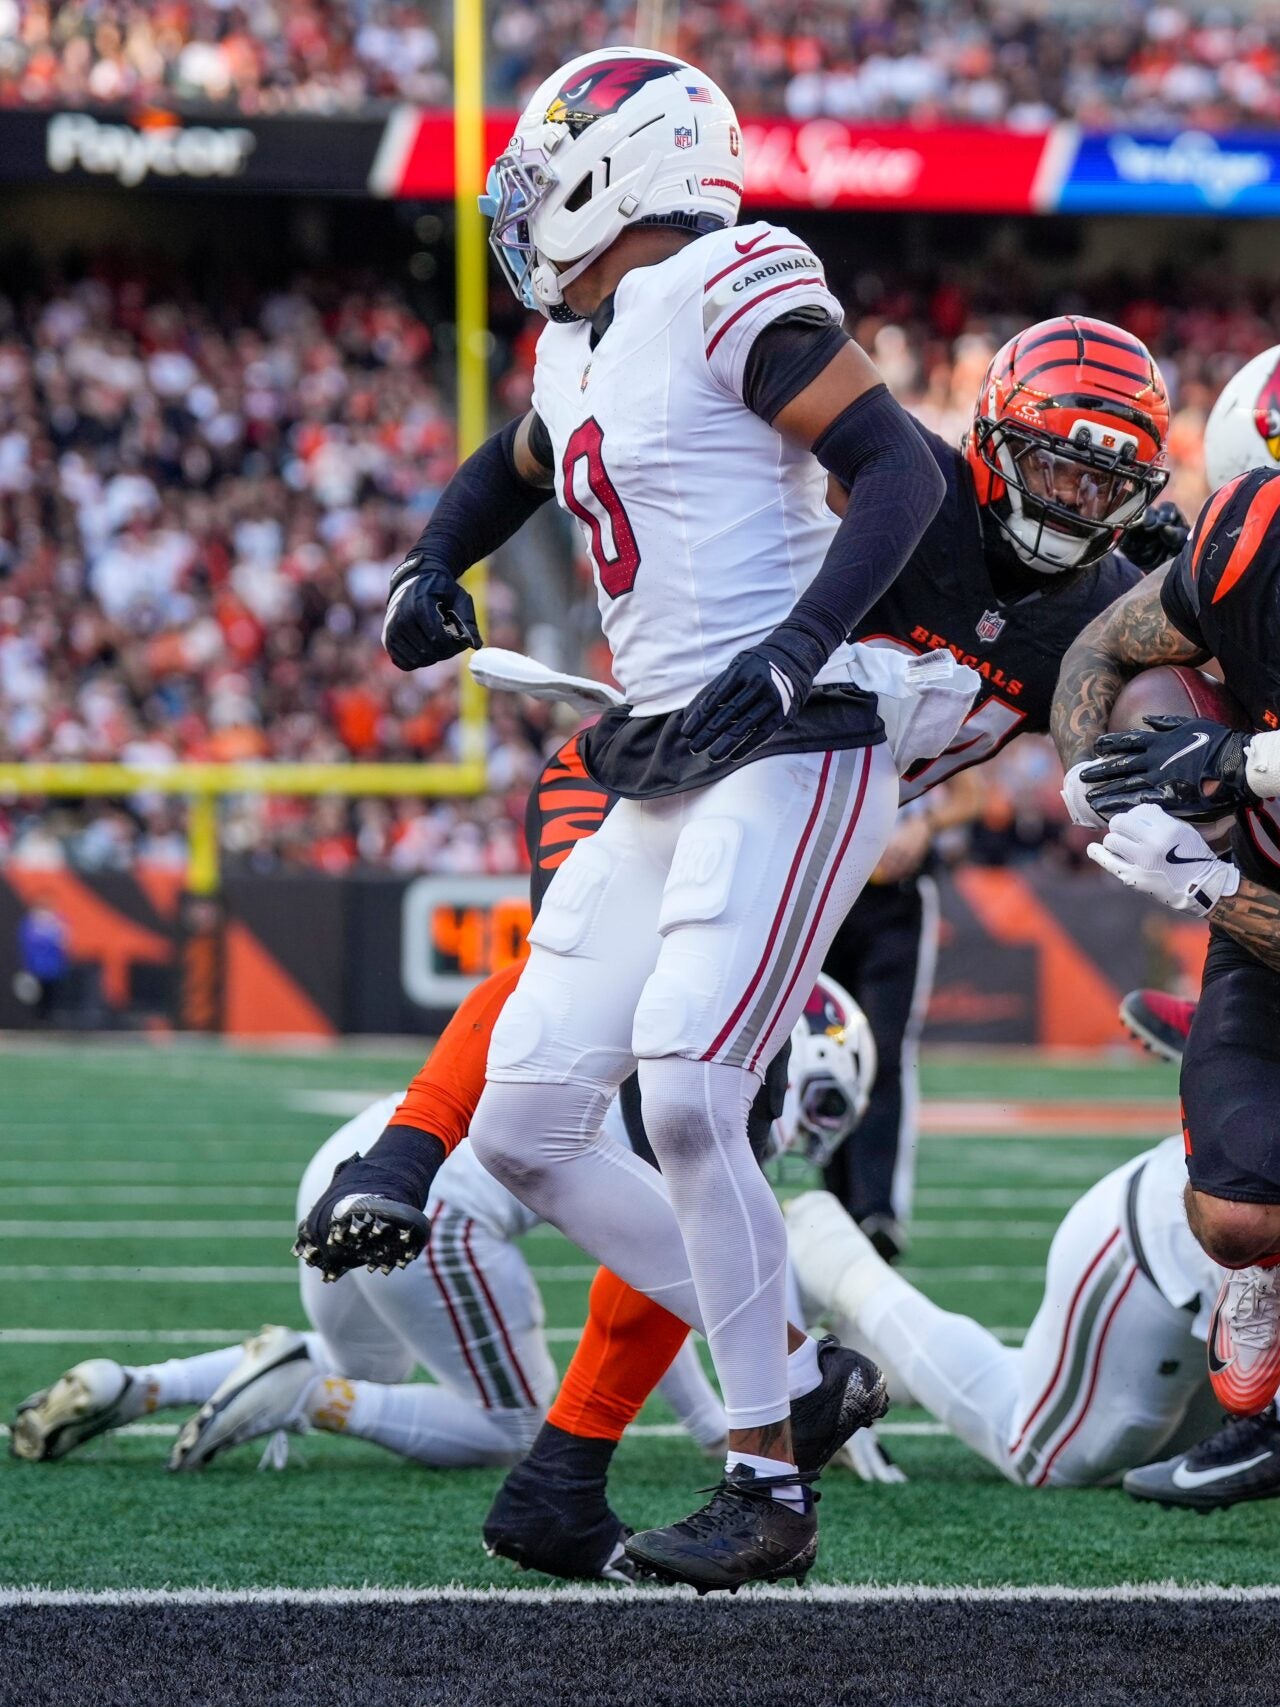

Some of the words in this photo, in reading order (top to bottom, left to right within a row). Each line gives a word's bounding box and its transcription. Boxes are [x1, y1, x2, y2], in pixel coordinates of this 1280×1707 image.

[729, 126, 739, 157] 0
[732, 257, 817, 293] CARDINALS
[562, 415, 641, 600] 0
